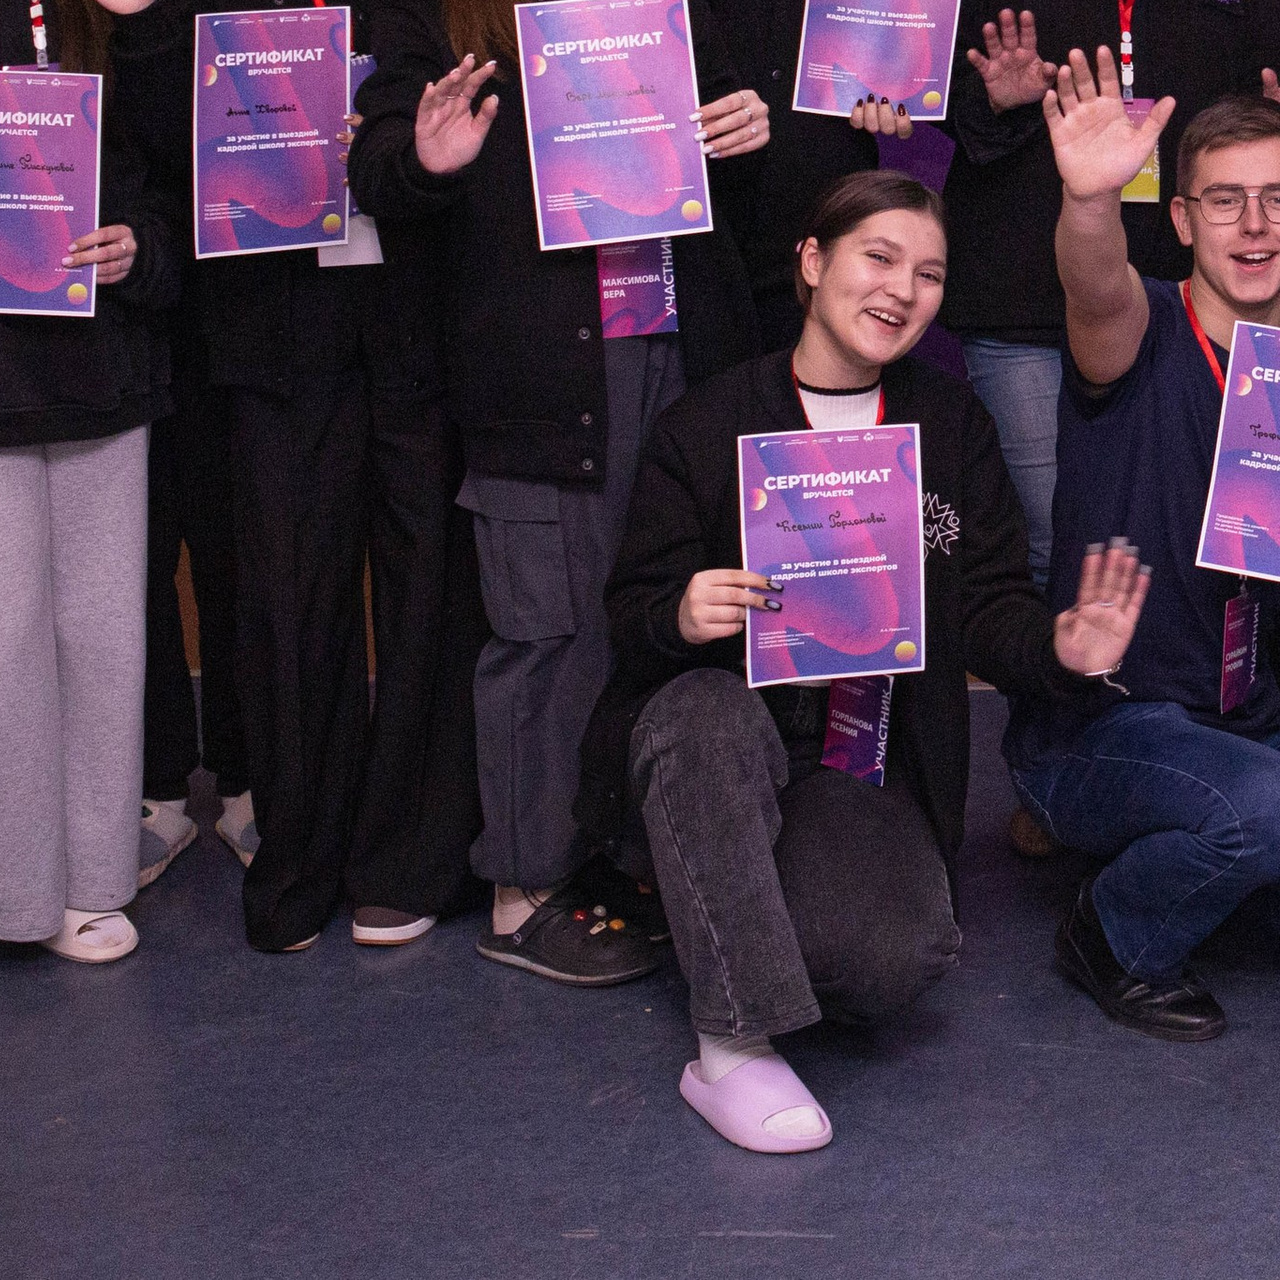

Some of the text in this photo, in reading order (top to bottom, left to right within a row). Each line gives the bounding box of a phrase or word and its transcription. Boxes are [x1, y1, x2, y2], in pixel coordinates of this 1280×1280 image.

[826, 14, 866, 24] кадровой
[895, 21, 936, 29] экспертов
[847, 8, 880, 16] участие
[887, 12, 928, 20] выездной
[543, 31, 663, 56] СЕРТИФИКАТ
[215, 48, 324, 67] СЕРТИФИКАТ
[580, 53, 629, 64] ВРУЧАЕТСЯ
[248, 67, 291, 76] ВРУЧАЕТСЯ
[0, 111, 75, 127] ИФИКАТ
[575, 121, 611, 132] участие
[619, 113, 664, 125] выездной
[0, 128, 38, 136] УЧАЕТСЯ
[237, 134, 270, 143] участие
[278, 129, 319, 138] выездной
[554, 123, 676, 142] кадровой школе экспертов
[217, 143, 257, 153] кадровой
[287, 139, 329, 147] экспертов
[20, 193, 64, 202] выездной
[29, 204, 74, 212] экспертов
[603, 275, 661, 287] МАКСИМОВА
[660, 237, 677, 316] УЧАСТНИ
[604, 290, 626, 299] ВЕРА
[764, 468, 891, 490] СЕРТИФИКАТ
[803, 489, 854, 499] ВРУЧАЕТСЯ
[793, 560, 831, 570] участие
[841, 554, 887, 565] выездной
[771, 564, 898, 580] кадровой школе экспертов
[831, 709, 873, 733] ГОРЛАНОВА
[831, 721, 858, 738] КСЕНИЯ
[875, 688, 891, 770] УЧАСТНИК
